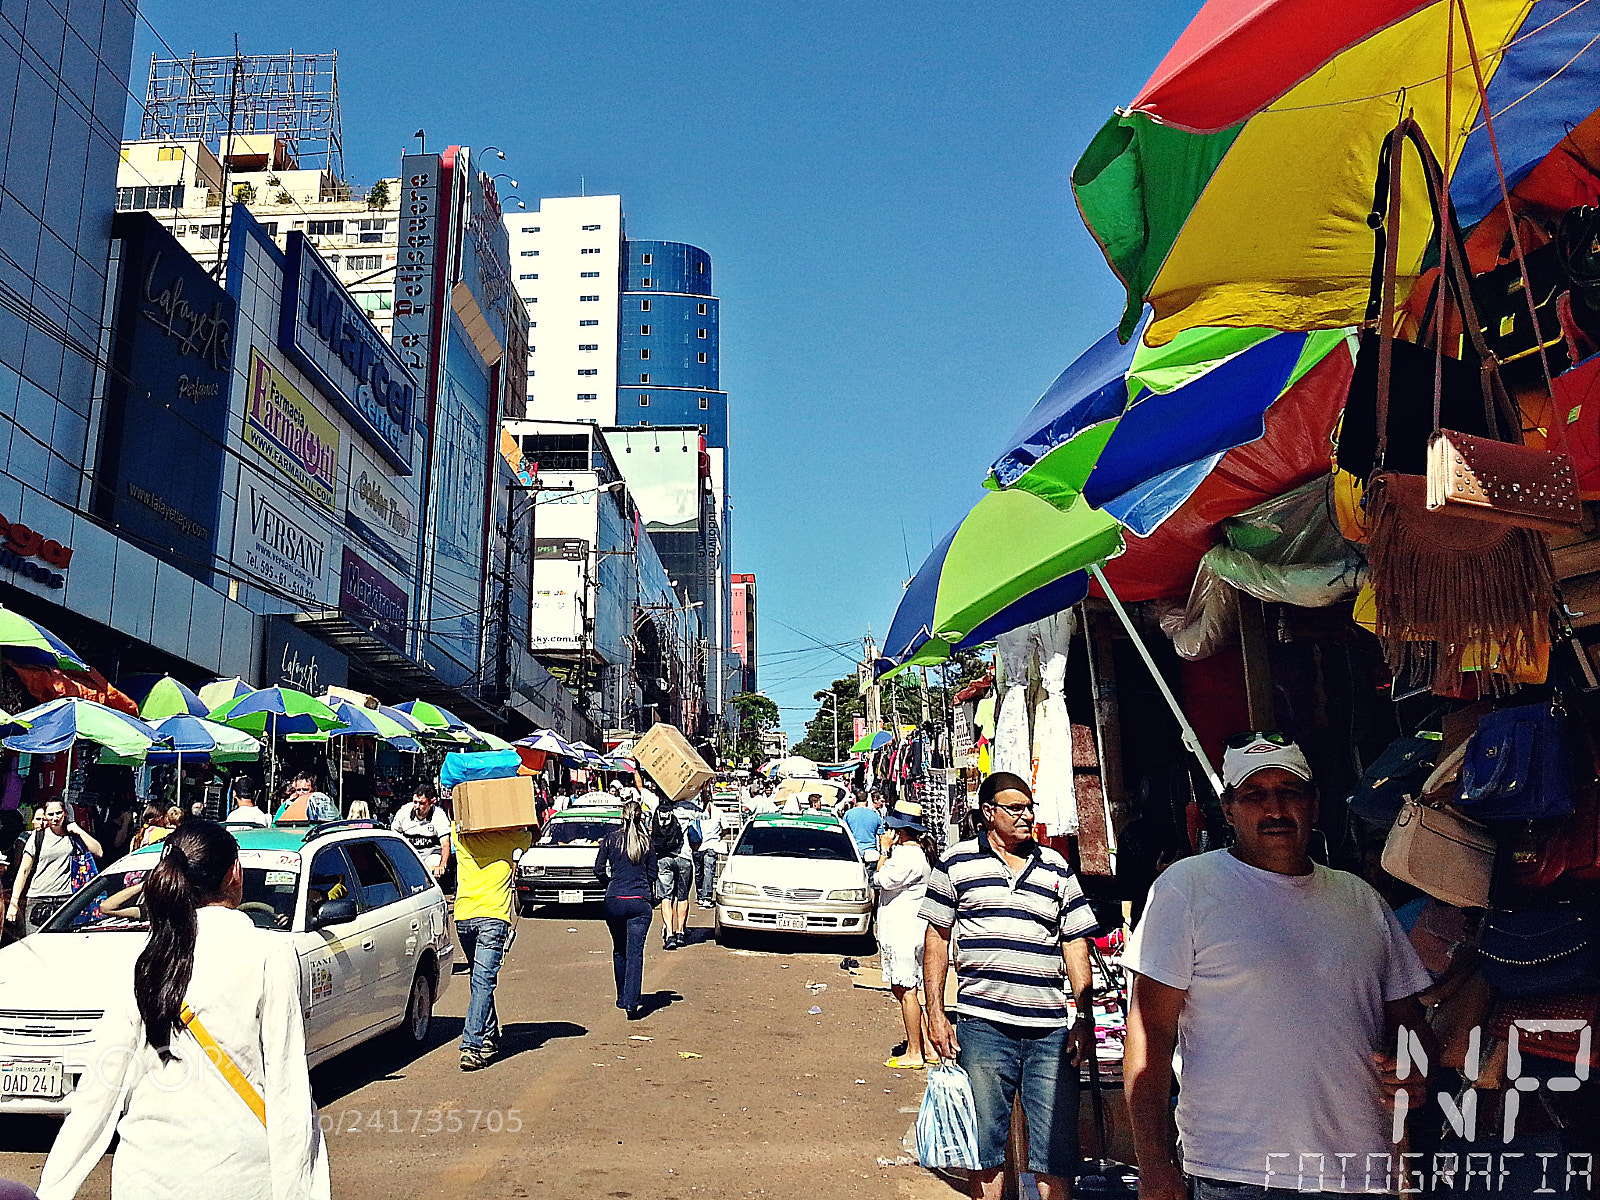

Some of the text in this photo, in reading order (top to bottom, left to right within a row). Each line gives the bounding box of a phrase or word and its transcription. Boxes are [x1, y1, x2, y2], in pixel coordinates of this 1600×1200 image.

[395, 172, 432, 318] Petisquera
[144, 250, 232, 372] Lafayette
[306, 268, 415, 436] Marcel
[270, 380, 305, 428] Farmacia
[355, 383, 403, 448] Center
[250, 429, 333, 506] WWW.FARMAUTIL.COM
[359, 470, 389, 522] Golden
[245, 549, 259, 570] Tel.
[260, 560, 274, 579] 595
[278, 572, 287, 588] 61
[255, 541, 314, 590] www.versani.com.py
[310, 957, 332, 968] TAXI
[33, 1074, 55, 1093] 241
